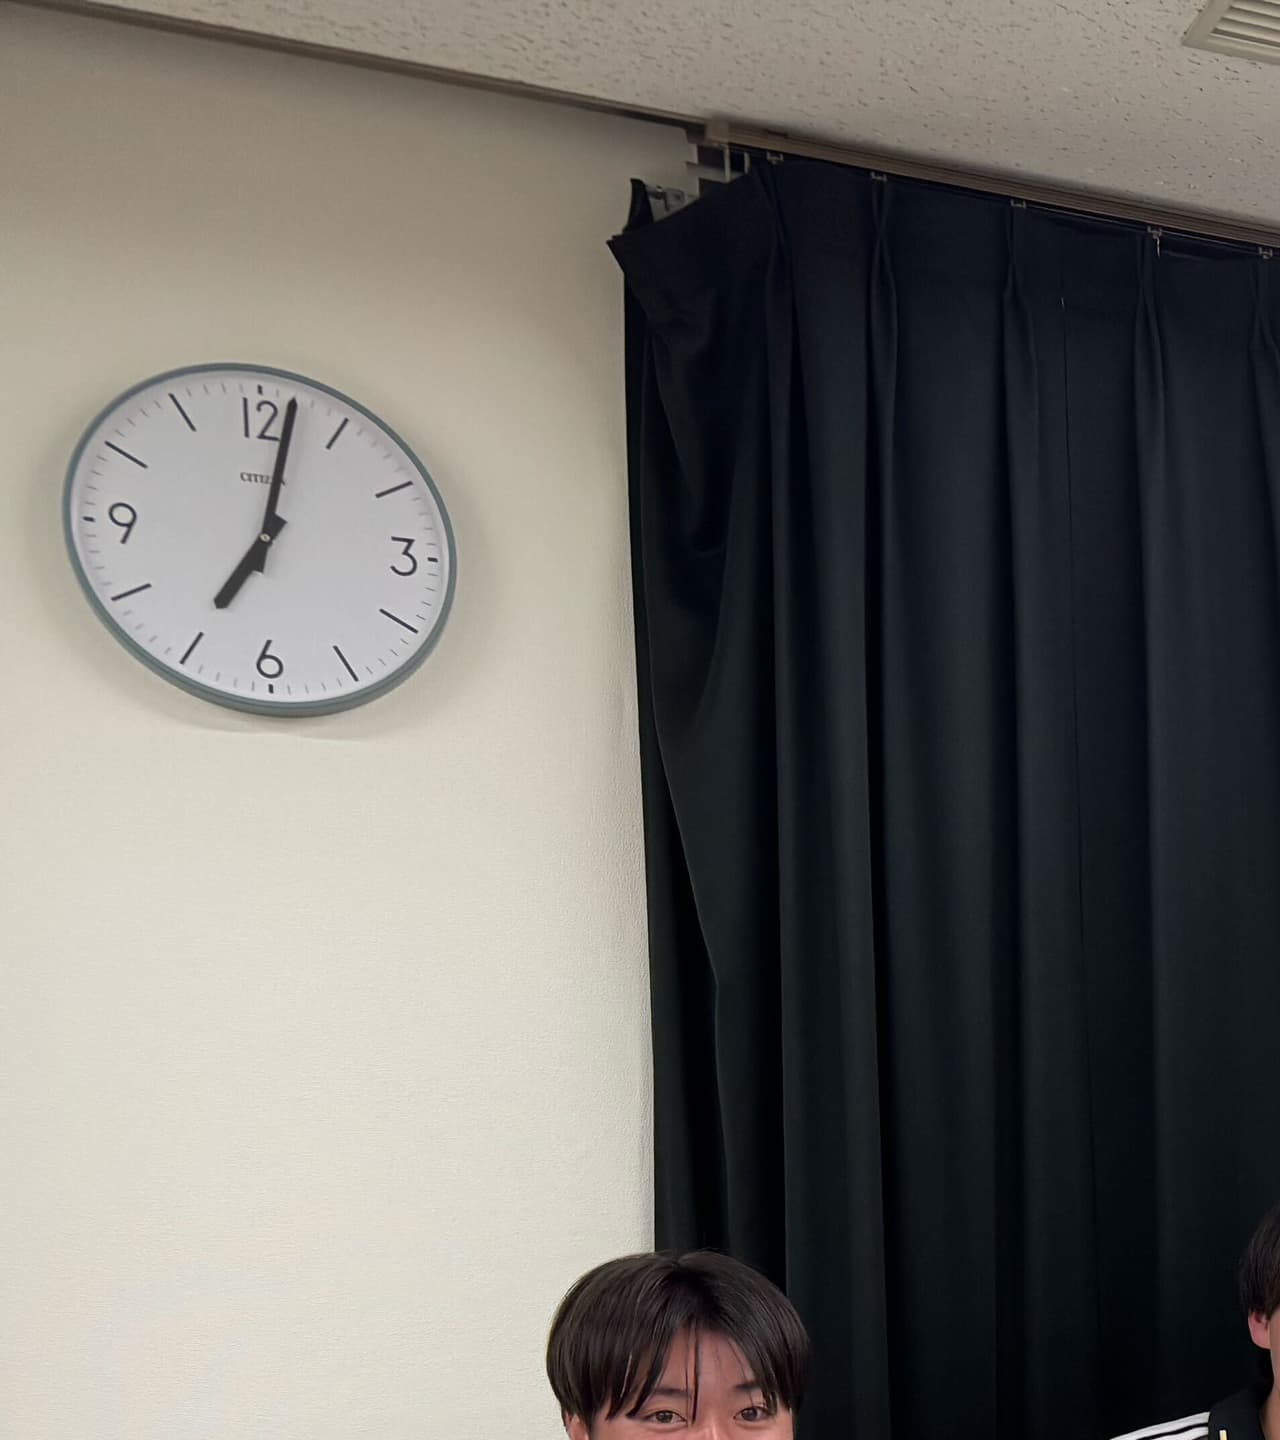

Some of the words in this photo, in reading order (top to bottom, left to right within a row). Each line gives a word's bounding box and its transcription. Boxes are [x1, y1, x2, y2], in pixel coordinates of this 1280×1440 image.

[242, 396, 281, 441] 12
[240, 471, 286, 486] CITIZ
[108, 502, 138, 544] 9
[389, 536, 419, 577] 3
[255, 639, 285, 679] 6
